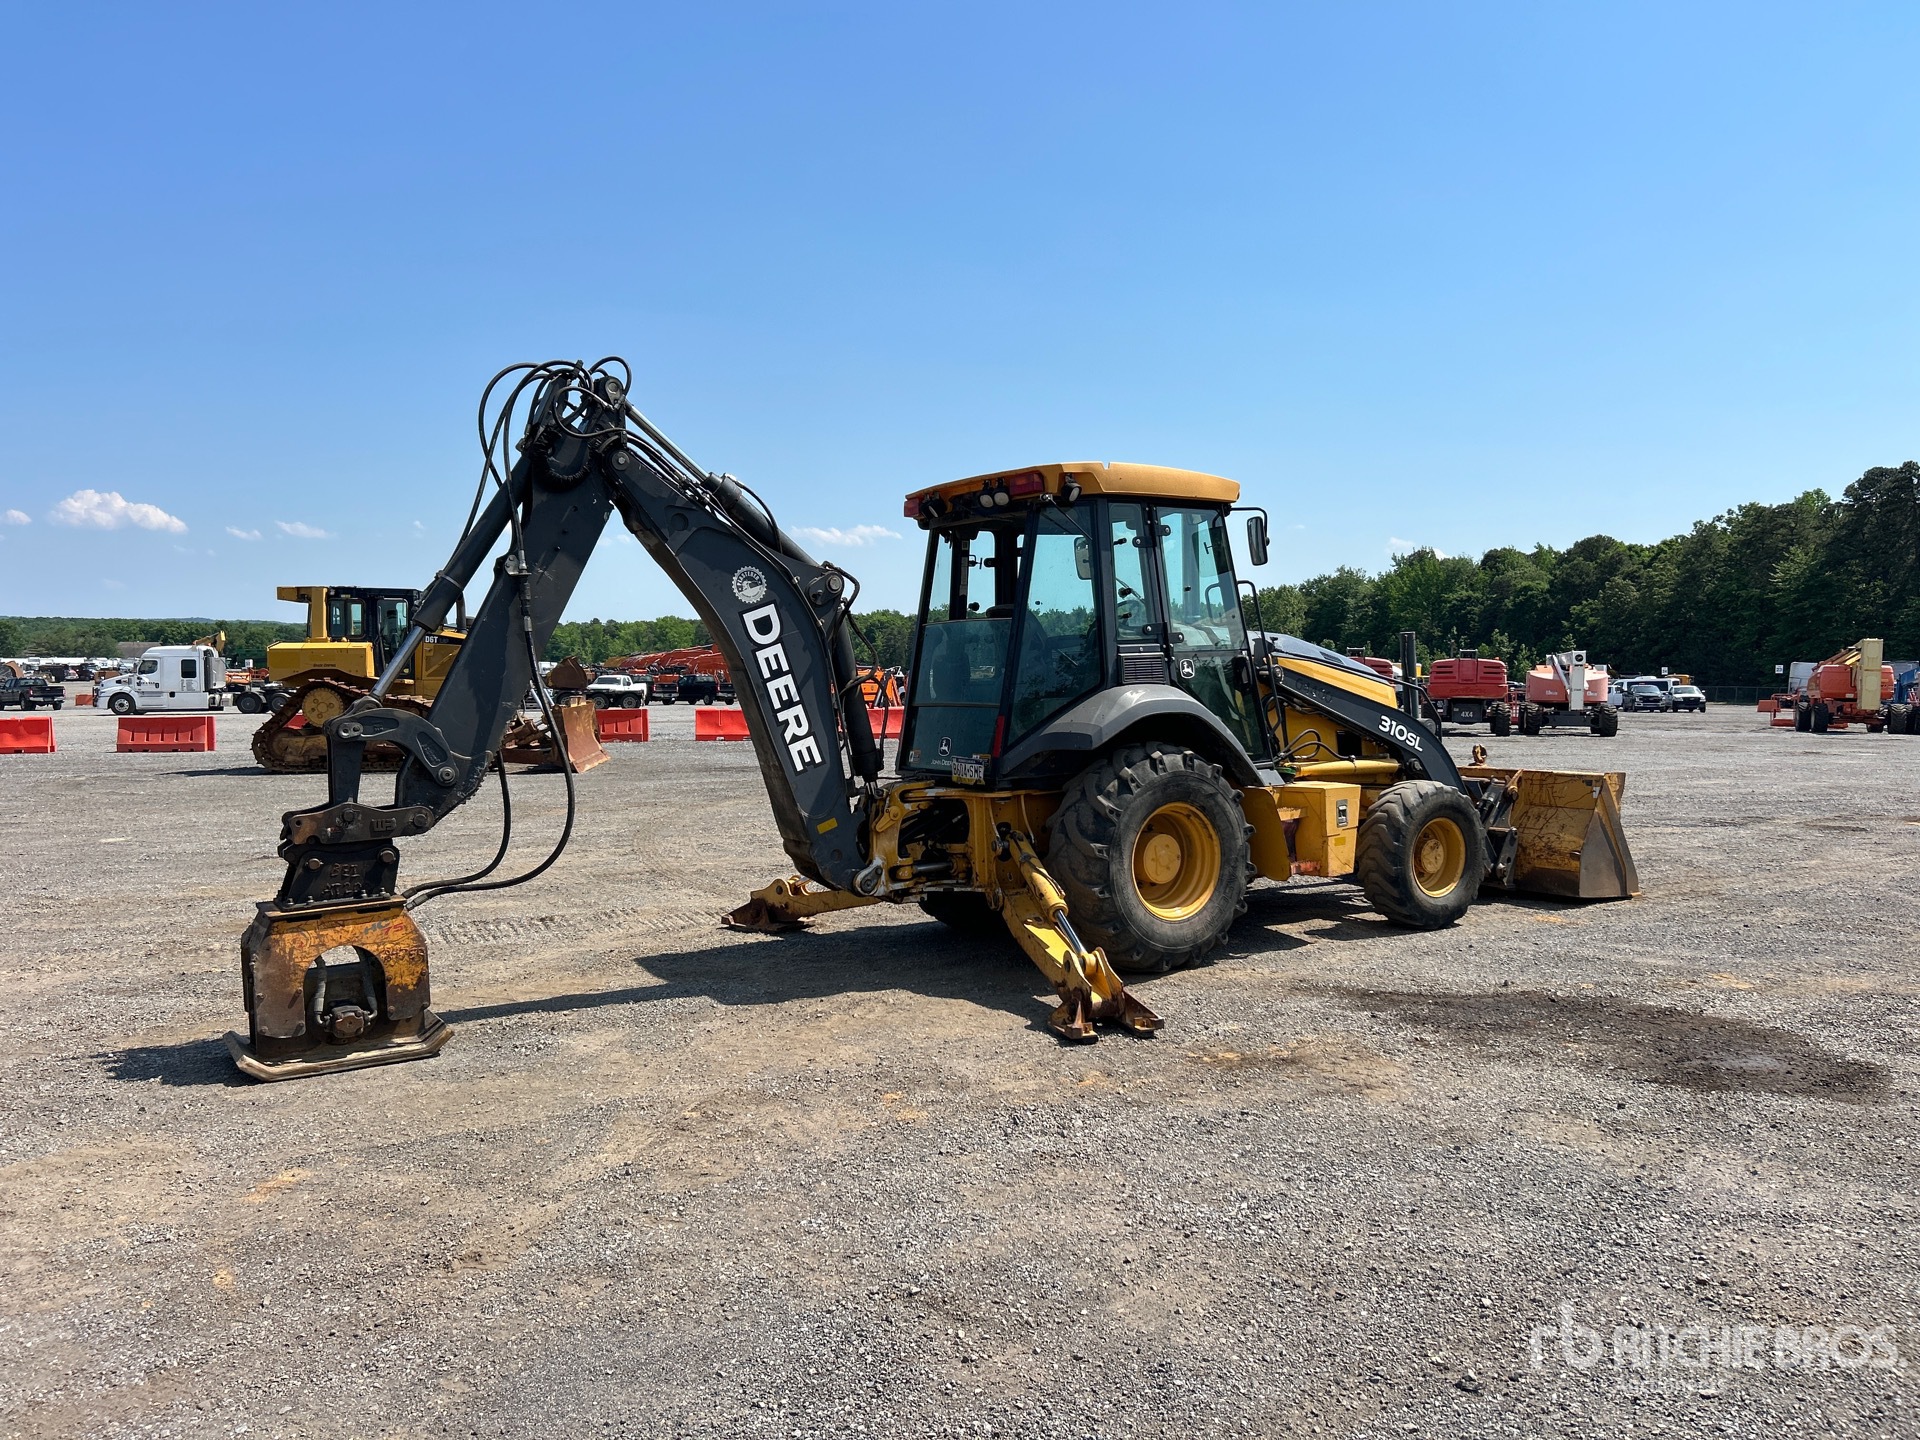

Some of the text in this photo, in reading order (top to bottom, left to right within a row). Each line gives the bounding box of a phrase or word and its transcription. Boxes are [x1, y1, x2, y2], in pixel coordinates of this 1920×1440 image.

[425, 635, 439, 644] D6T
[742, 603, 823, 772] DEERE
[1460, 711, 1474, 719] 4X4
[1378, 715, 1424, 752] 310SL
[363, 918, 391, 935] HC
[383, 922, 405, 936] 75
